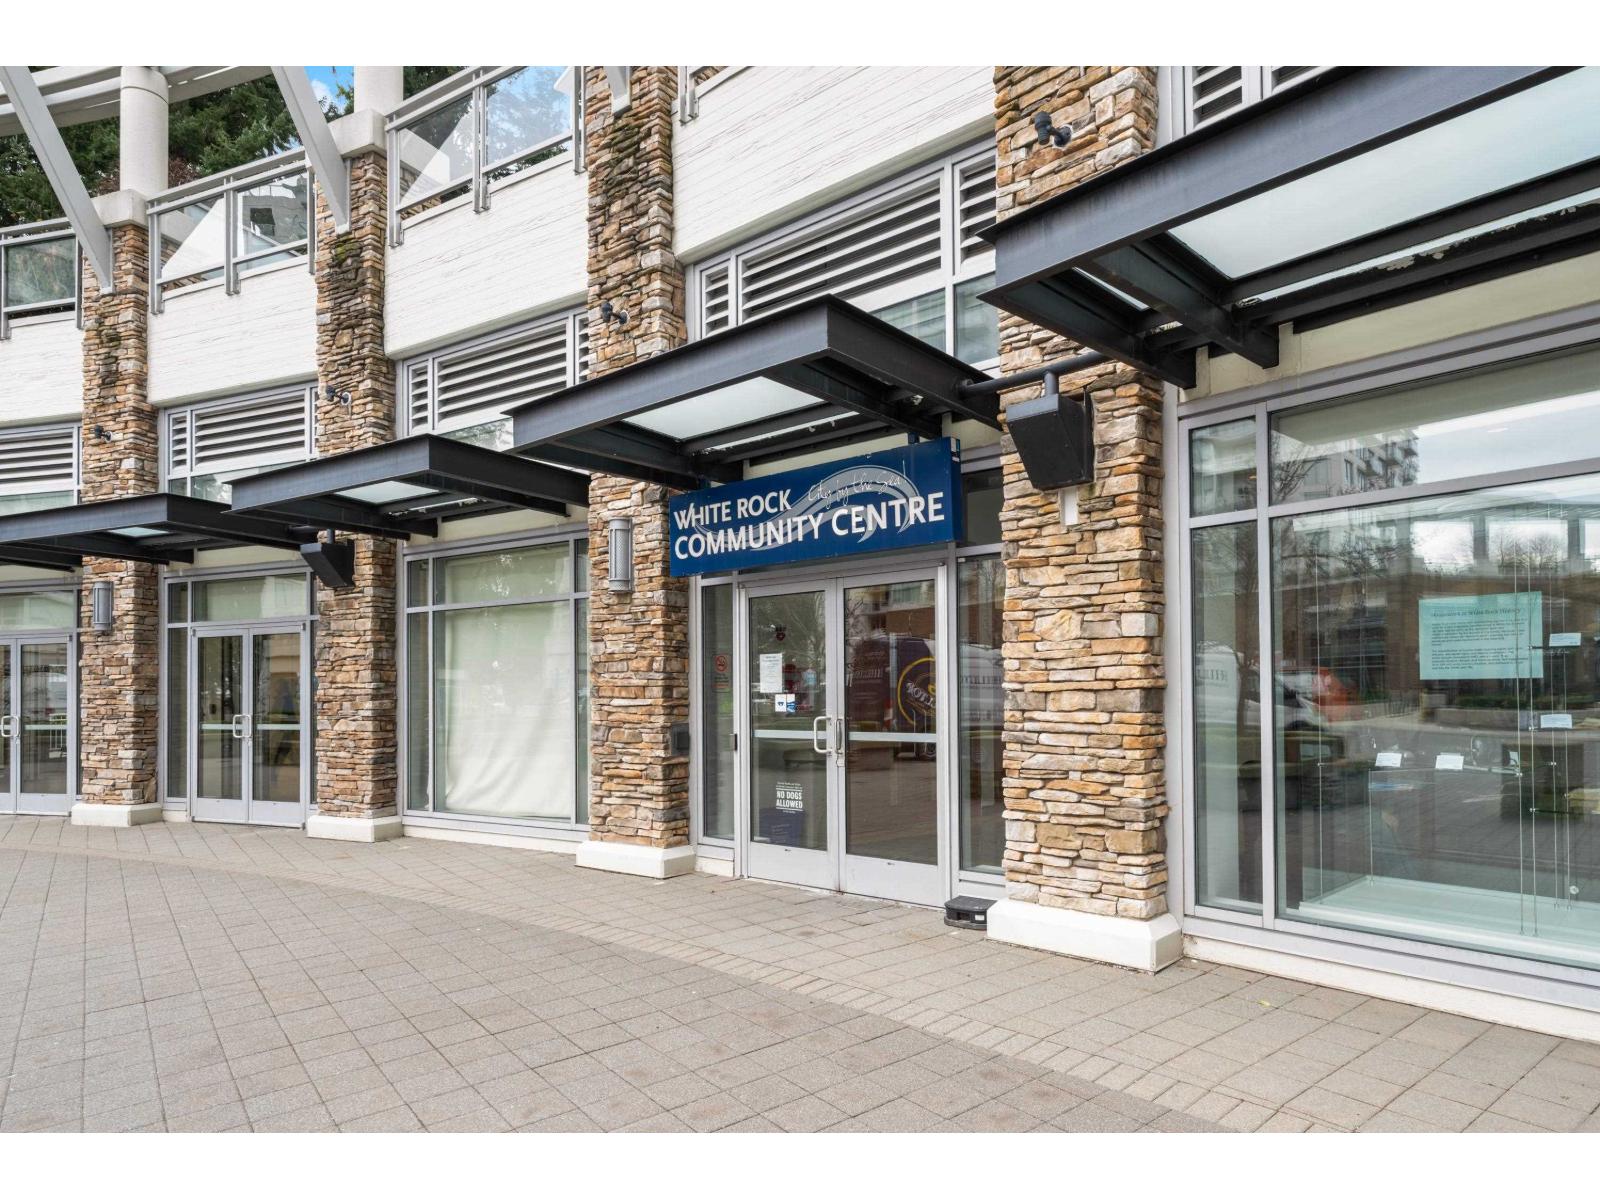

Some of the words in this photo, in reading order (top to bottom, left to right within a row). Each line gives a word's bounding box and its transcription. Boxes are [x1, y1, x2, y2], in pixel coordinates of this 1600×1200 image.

[674, 502, 732, 530] WHITE
[737, 489, 792, 519] ROCK
[674, 513, 824, 560] COMMUNITY
[831, 491, 945, 536] CENTRE
[776, 799, 803, 808] ALLOWED
[777, 790, 785, 798] NO
[786, 791, 802, 799] DOGS
